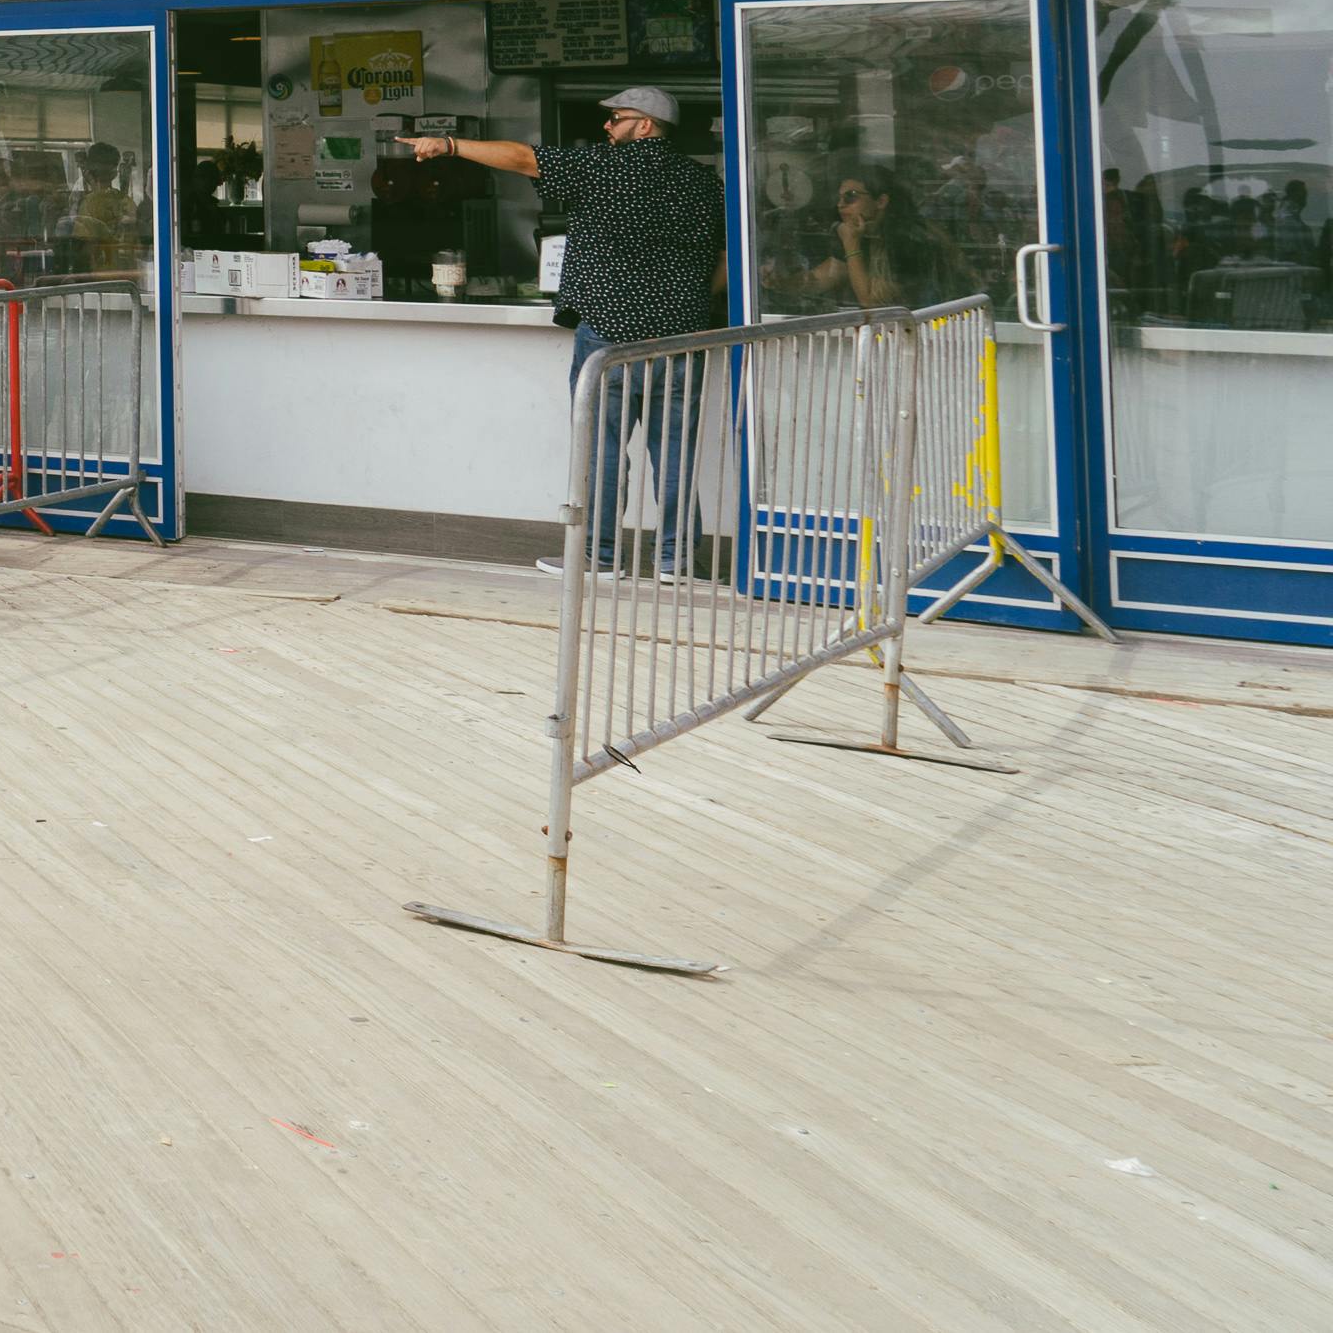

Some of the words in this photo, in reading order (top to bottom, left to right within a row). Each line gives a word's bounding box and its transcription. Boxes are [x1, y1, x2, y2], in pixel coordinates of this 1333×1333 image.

[347, 67, 413, 90] Corona
[975, 74, 1032, 98] pep
[381, 84, 414, 101] Light
[435, 267, 462, 283] TIPS
